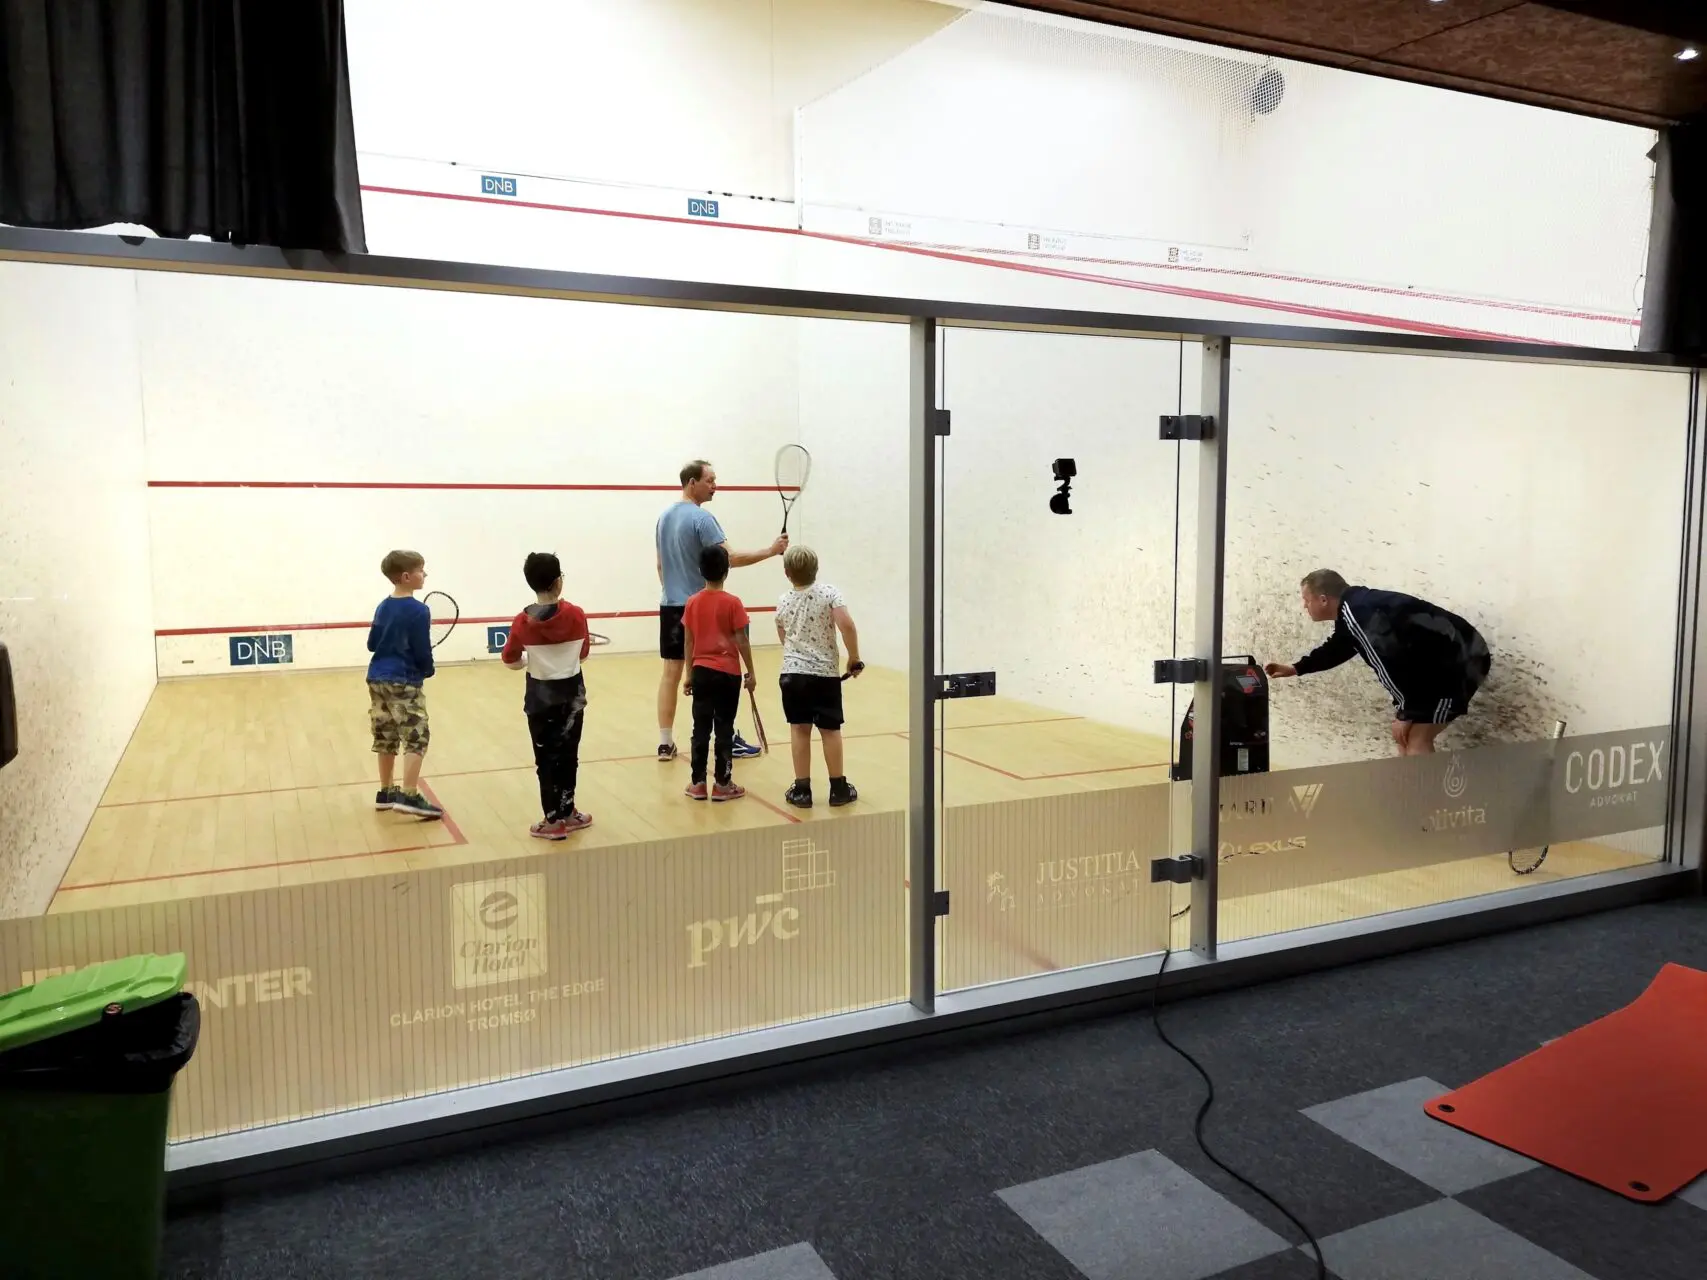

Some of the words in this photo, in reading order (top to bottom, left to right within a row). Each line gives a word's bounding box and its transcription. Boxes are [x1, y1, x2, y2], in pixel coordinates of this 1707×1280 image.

[485, 177, 514, 195] DNB
[691, 200, 716, 216] DNB
[237, 634, 286, 665] DNB
[1565, 740, 1665, 794] CODEX
[1036, 850, 1141, 885] JUSTITIA
[459, 934, 538, 959] Clarion
[686, 906, 800, 968] pwc
[472, 951, 526, 975] Hotel
[389, 1001, 464, 1028] CLARION
[470, 992, 522, 1014] HOTEL
[527, 985, 558, 1003] THE
[562, 978, 605, 998] EDGE
[467, 1008, 537, 1032] TROMSØ
